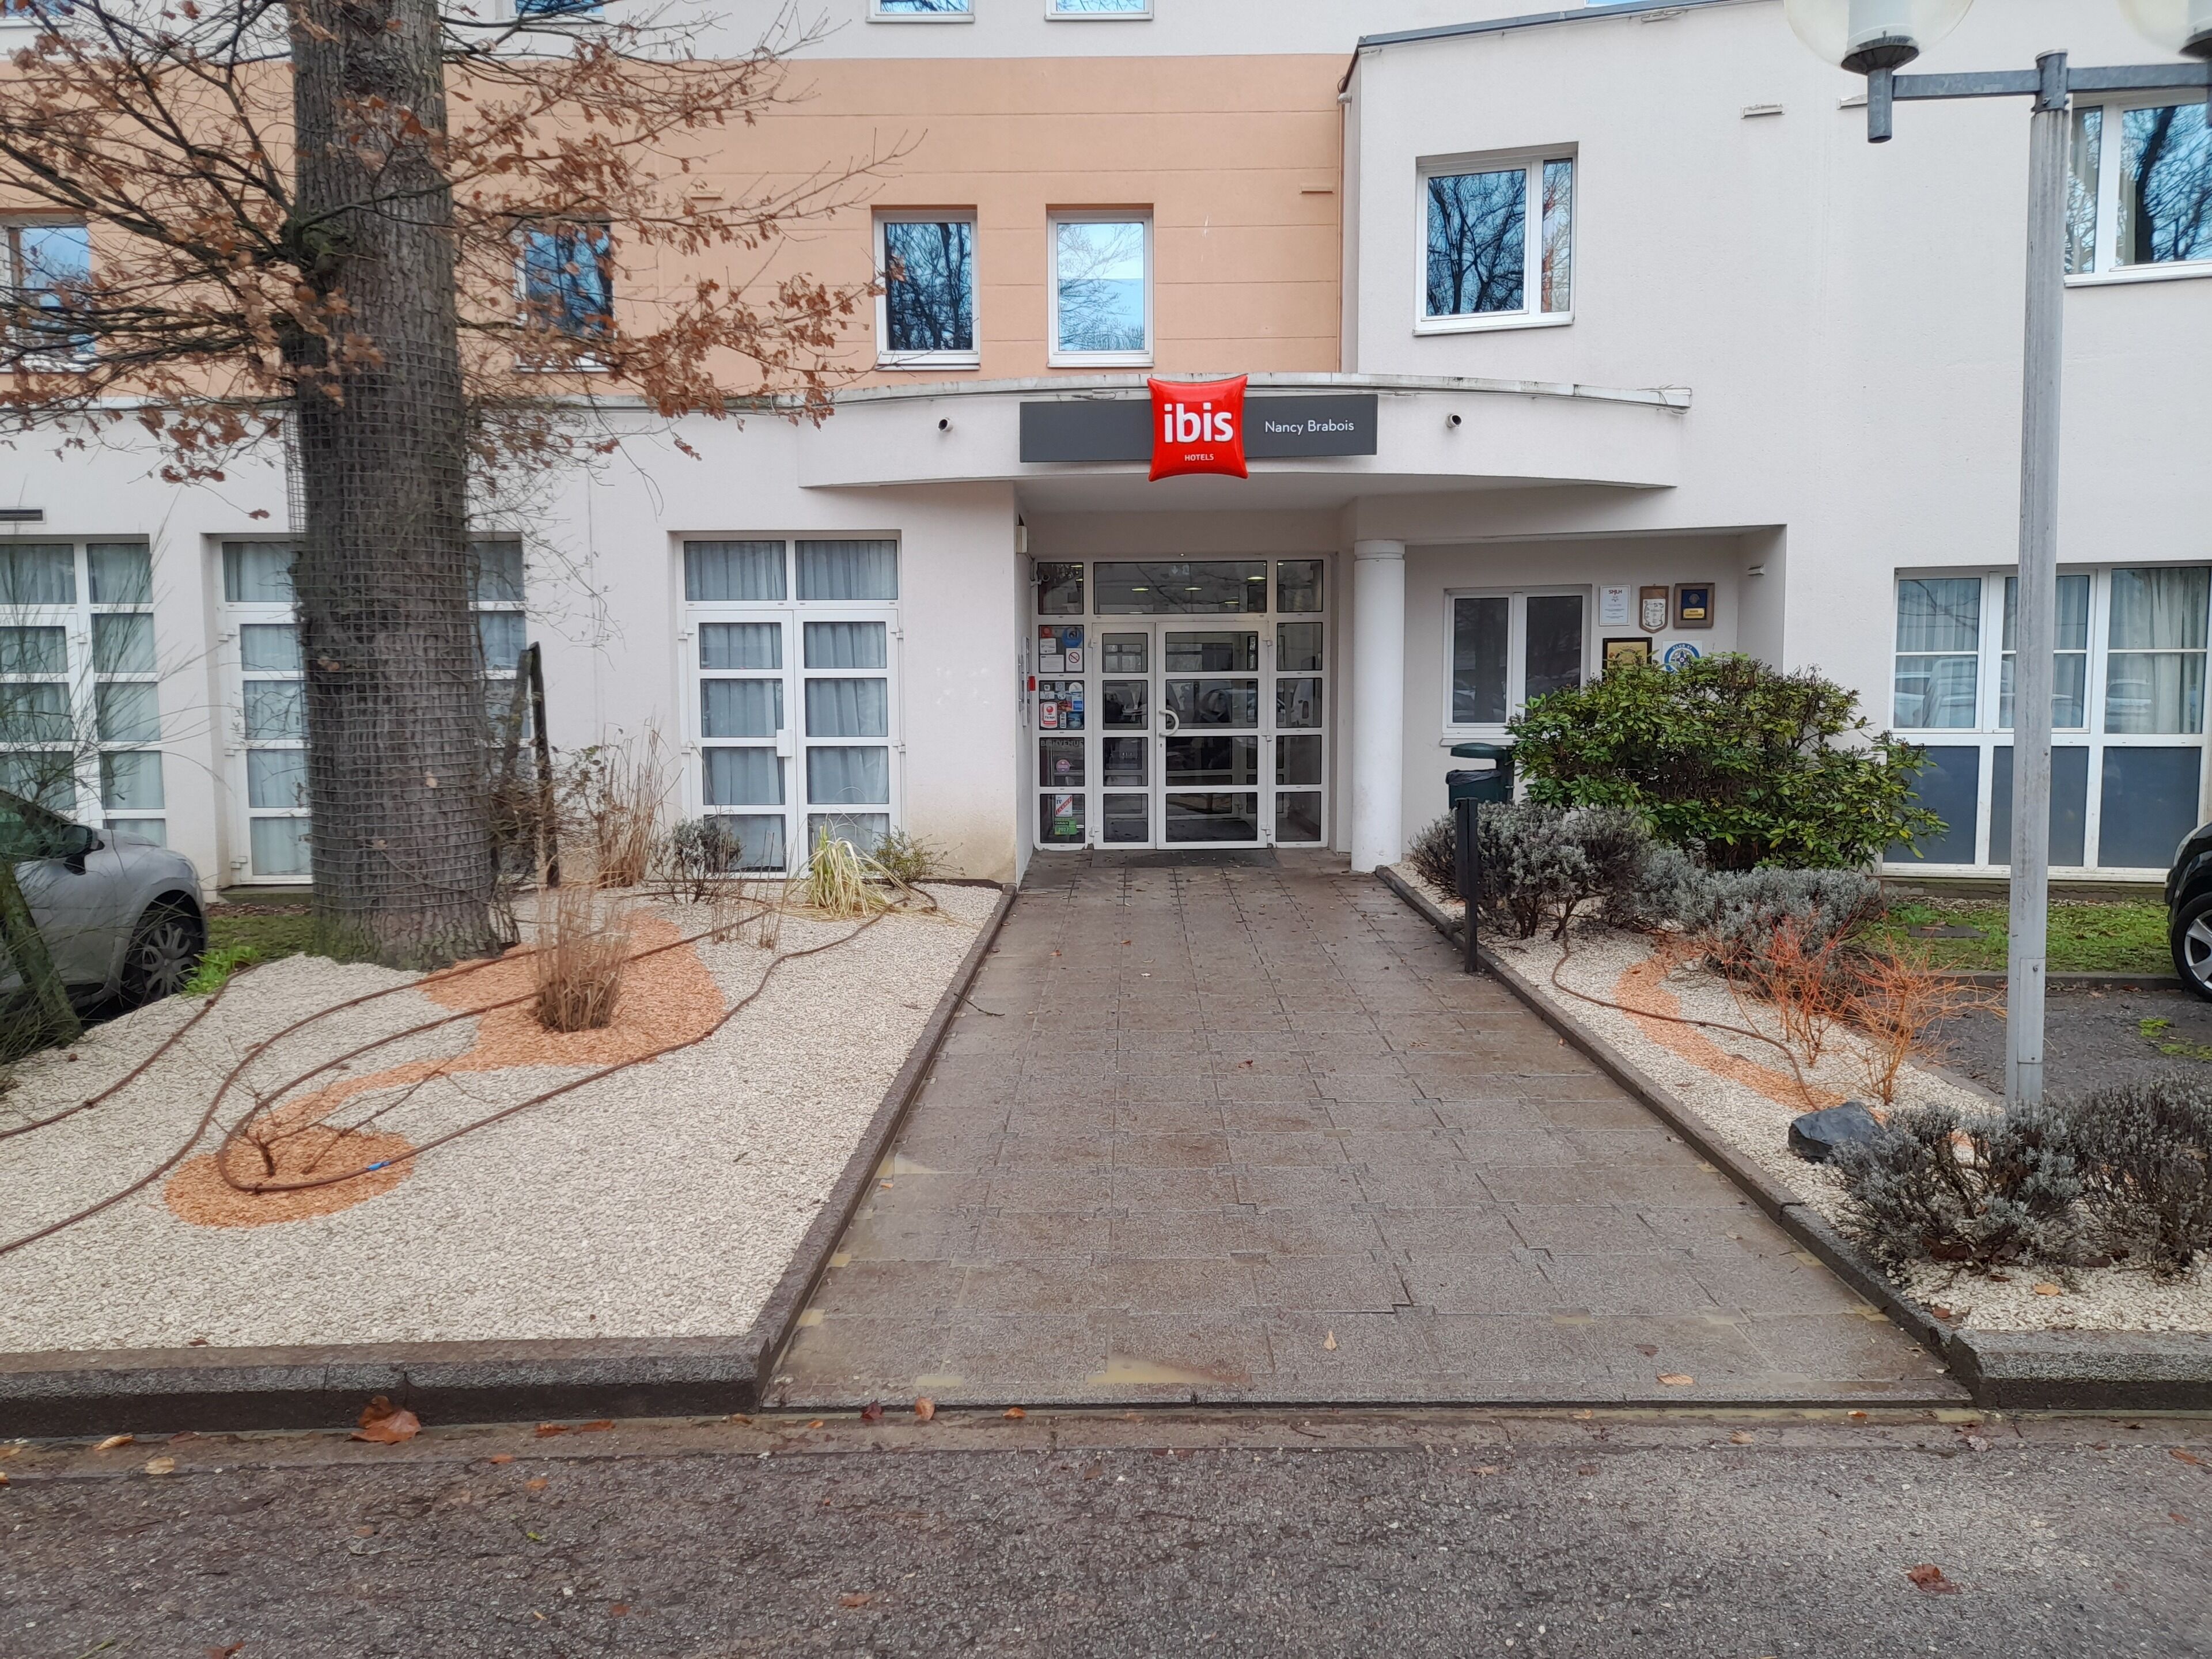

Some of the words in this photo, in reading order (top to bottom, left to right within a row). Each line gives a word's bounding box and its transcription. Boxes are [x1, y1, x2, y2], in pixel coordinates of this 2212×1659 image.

[1164, 402, 1233, 443] ibis
[1265, 421, 1304, 435] Nancy
[1308, 419, 1354, 432] Brabois
